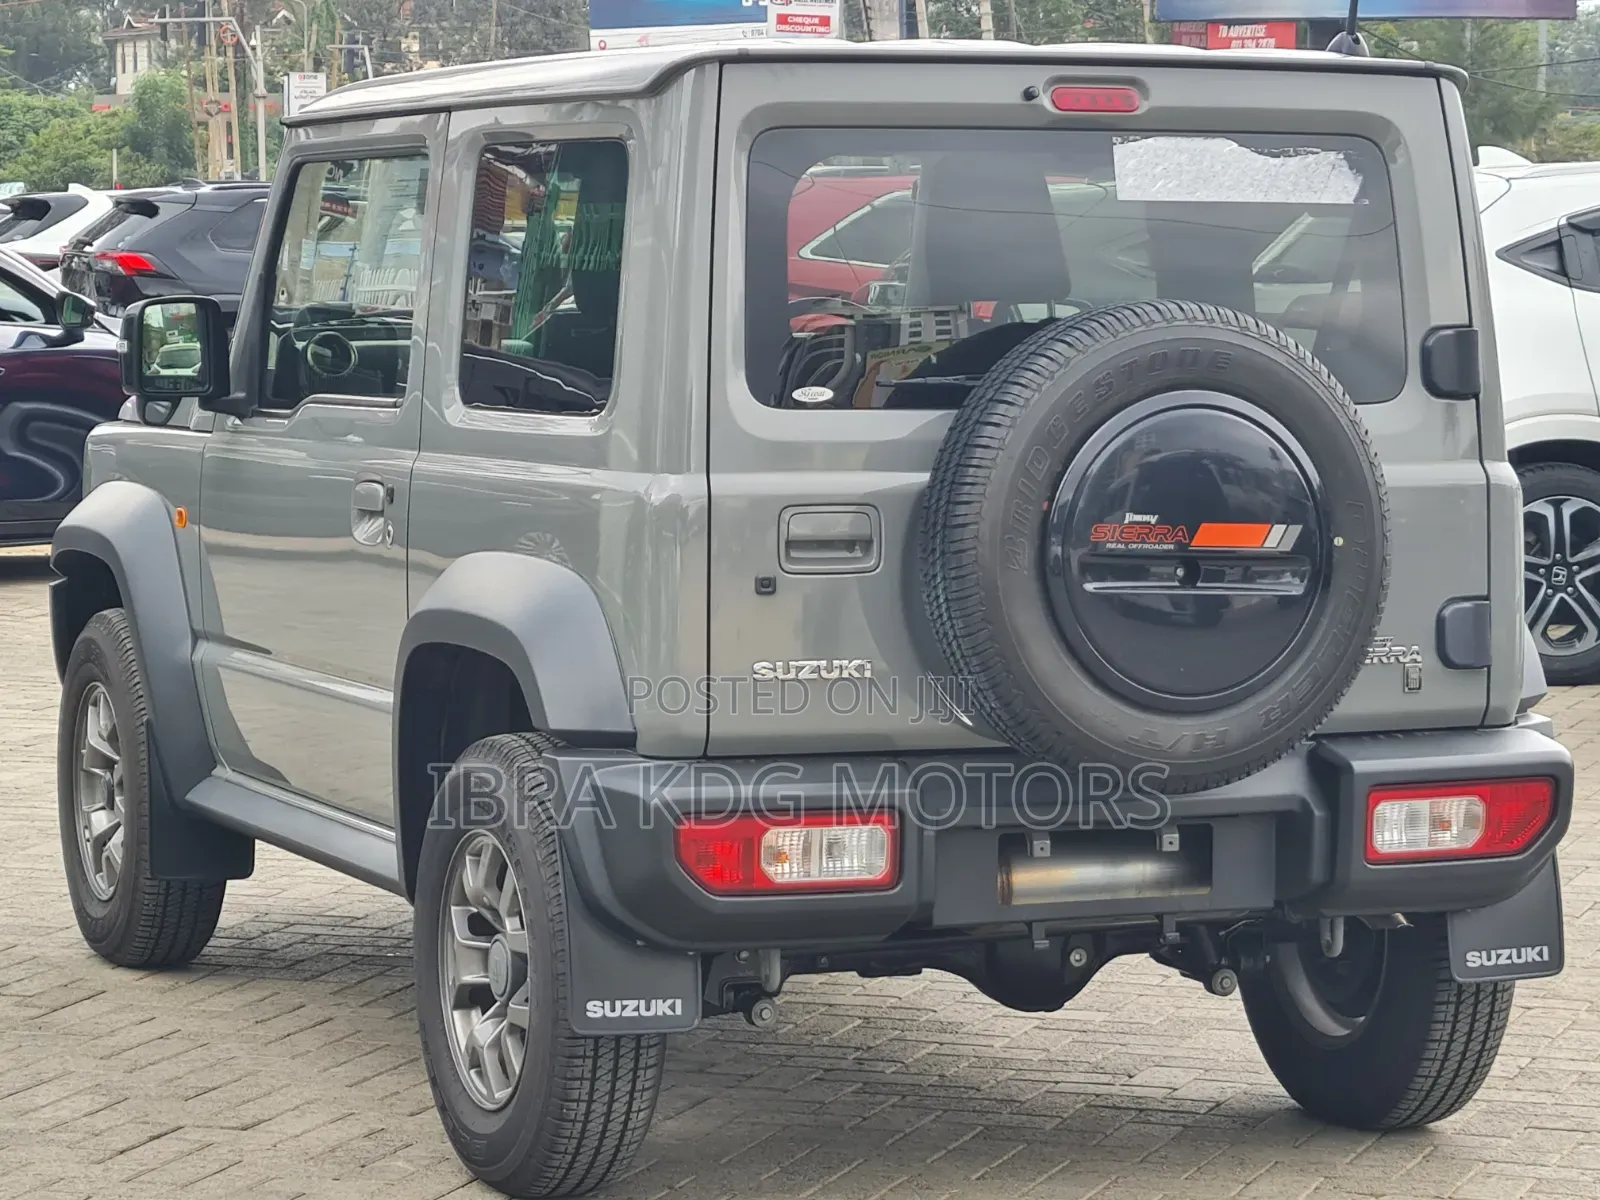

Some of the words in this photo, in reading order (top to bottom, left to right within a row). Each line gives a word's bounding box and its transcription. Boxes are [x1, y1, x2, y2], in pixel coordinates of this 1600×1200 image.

[777, 24, 830, 33] DISCOUNTING
[787, 16, 820, 24] CHEQUE
[1218, 25, 1228, 38] TO
[1228, 24, 1267, 37] ADVERTISE
[1090, 524, 1189, 542] SIERRA
[752, 659, 872, 681] SUZUKI
[1465, 945, 1549, 968] SUZUKI
[586, 999, 682, 1018] SUZUKI
